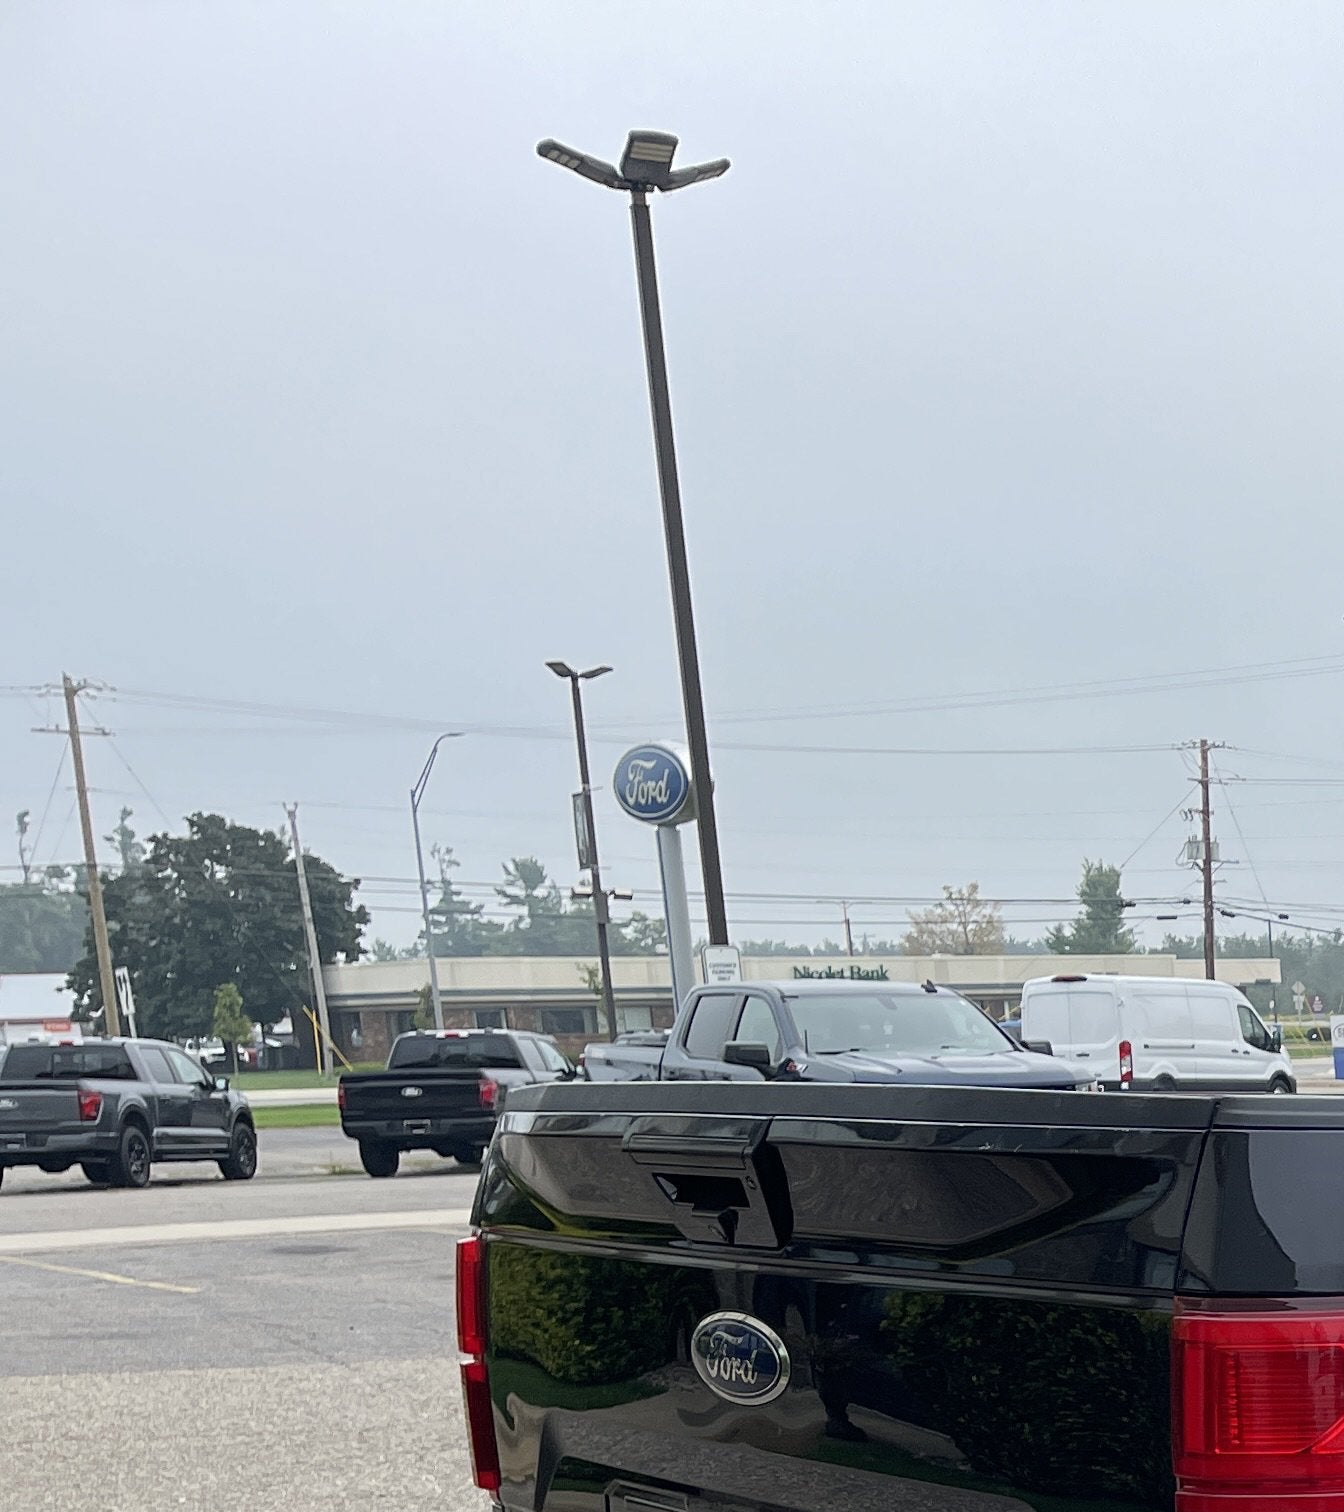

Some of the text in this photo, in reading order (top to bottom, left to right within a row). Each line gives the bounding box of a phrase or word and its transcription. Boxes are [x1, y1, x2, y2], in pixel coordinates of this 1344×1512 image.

[625, 759, 671, 807] Ford
[793, 963, 890, 981] Nicolet Bank
[705, 1330, 759, 1385] Ford
